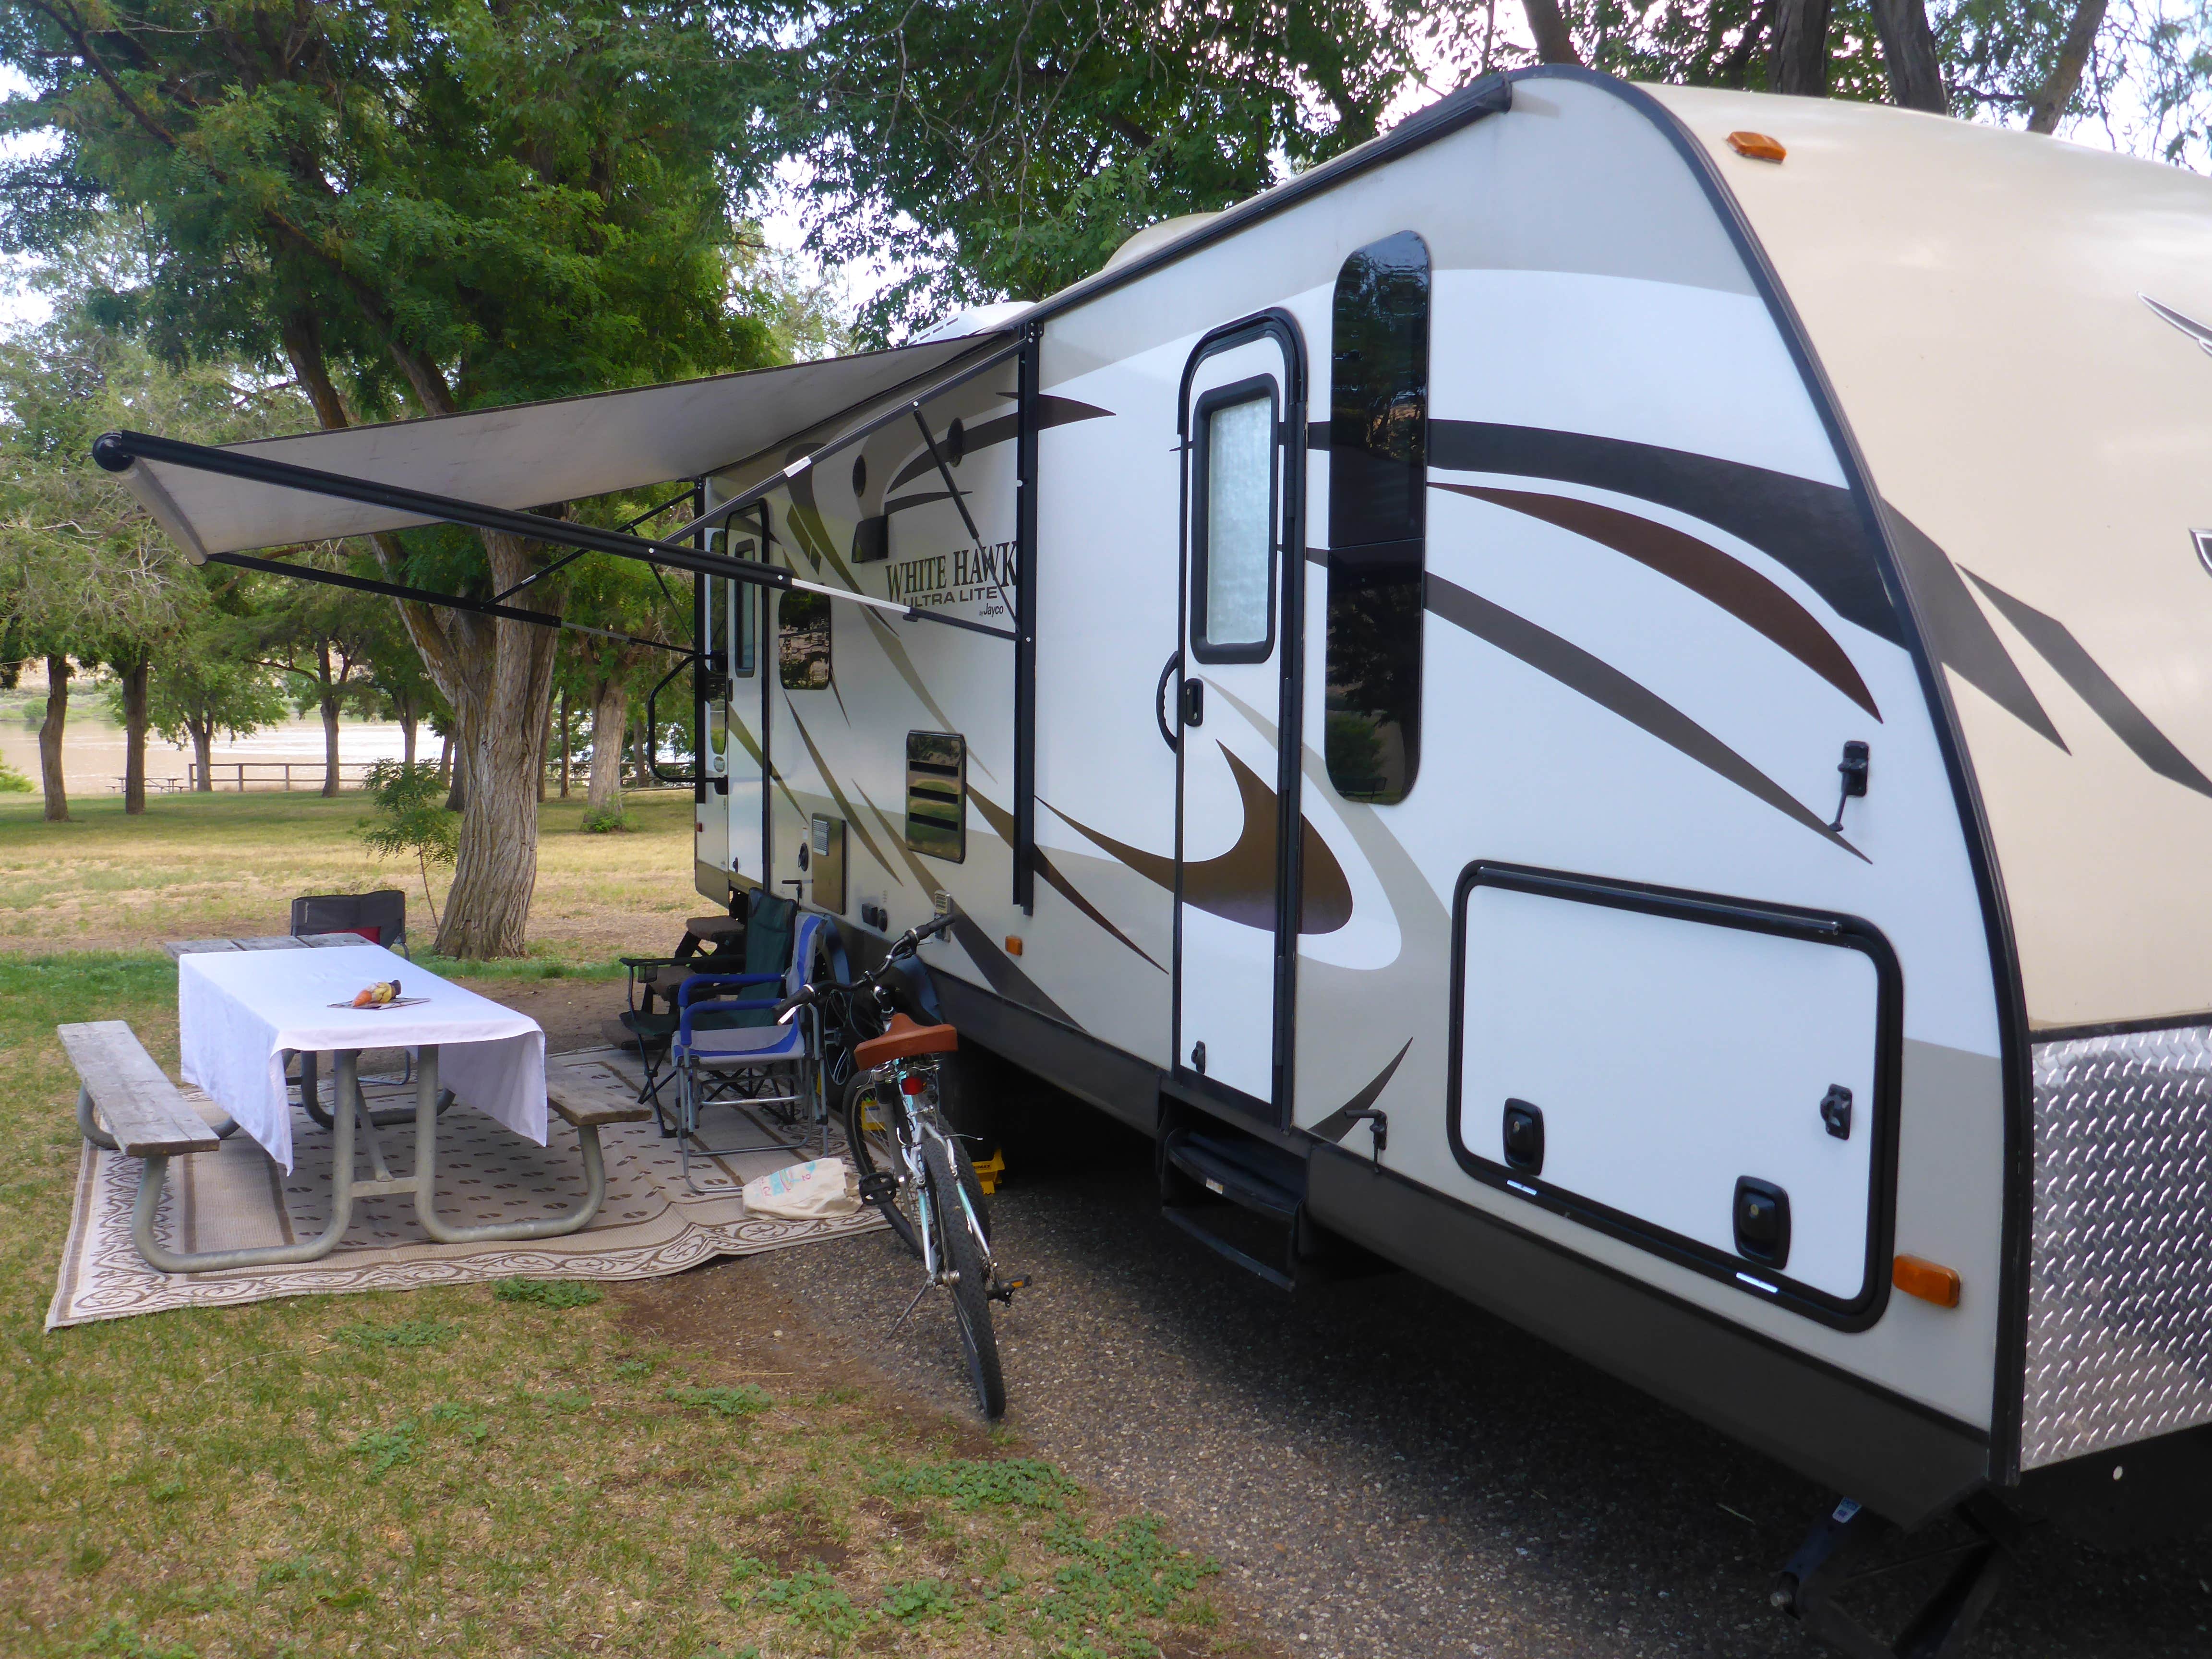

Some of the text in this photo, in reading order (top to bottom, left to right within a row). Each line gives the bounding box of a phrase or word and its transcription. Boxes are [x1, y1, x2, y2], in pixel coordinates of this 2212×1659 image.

[885, 541, 1017, 603] WHITE HAWK
[903, 586, 998, 608] ULTRA LITE
[984, 603, 1004, 618] Jayco
